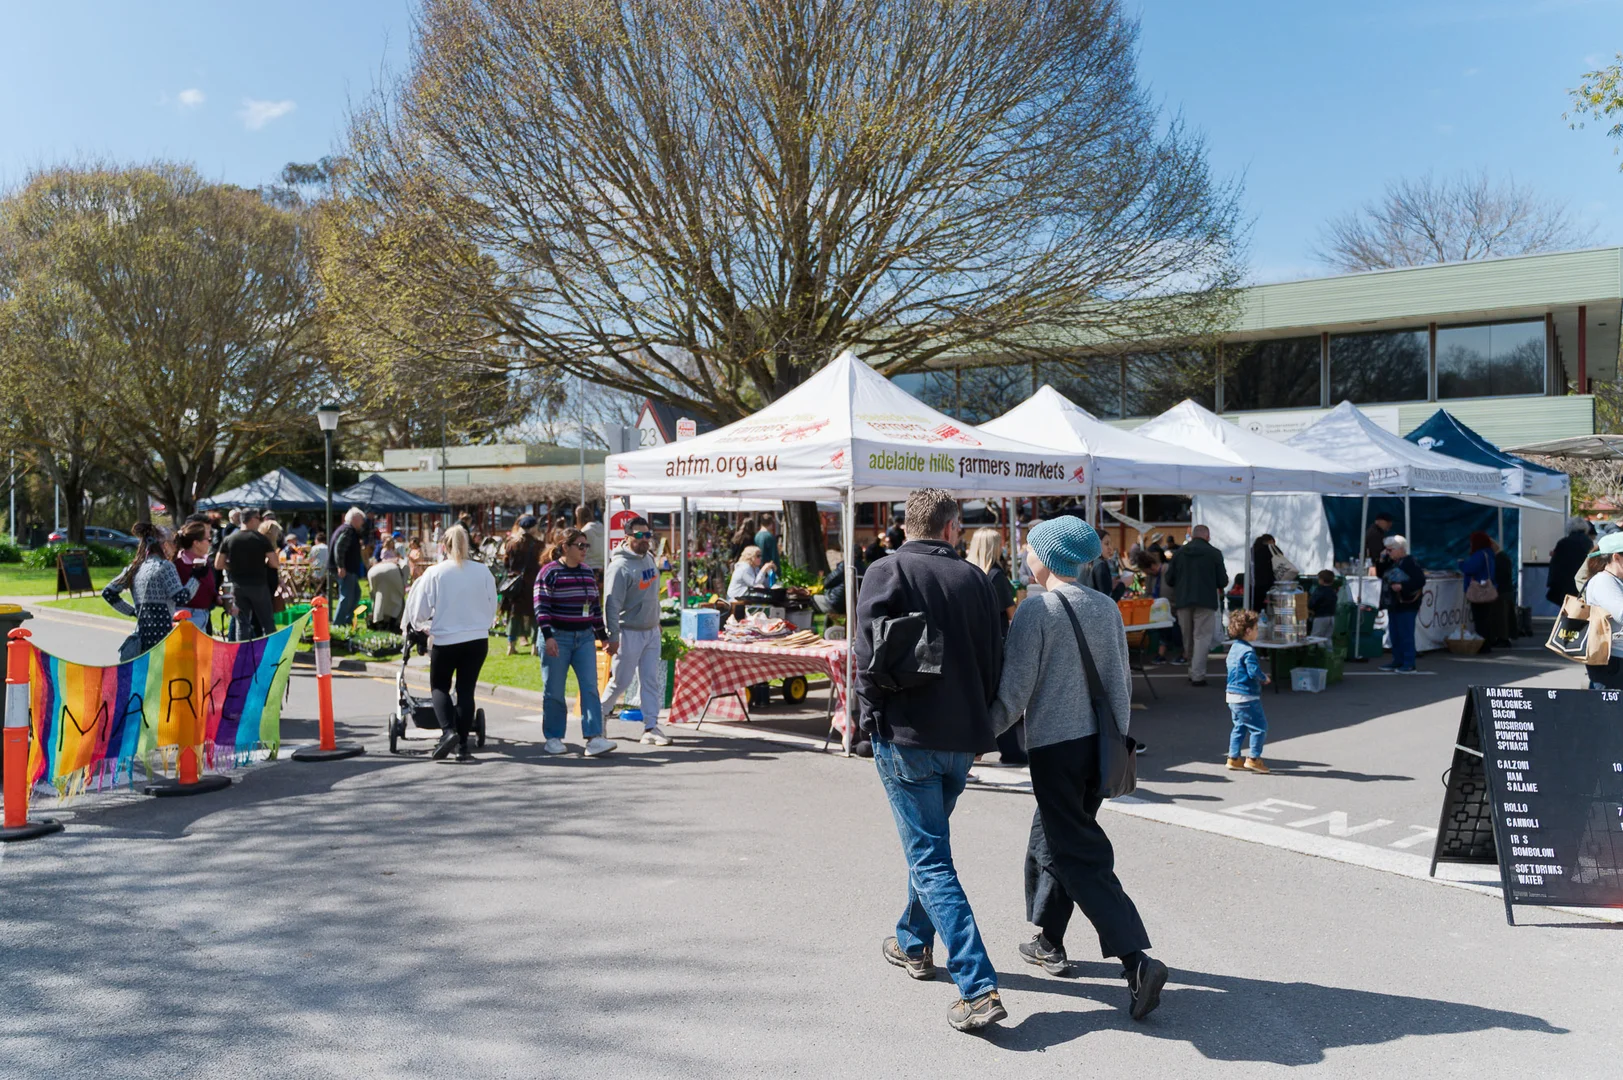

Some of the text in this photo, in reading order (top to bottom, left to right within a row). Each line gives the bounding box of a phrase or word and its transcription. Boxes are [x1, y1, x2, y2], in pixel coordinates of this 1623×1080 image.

[640, 428, 657, 447] 23
[665, 454, 778, 478] ahfm.org.au
[869, 450, 1065, 480] adelaide hills farmers markets
[1486, 688, 1523, 698] ARANCINE
[59, 657, 287, 752] MARKET
[1491, 699, 1533, 710] BOLOGNESE
[1492, 709, 1516, 719] BACON
[1494, 721, 1534, 731] MUSHROOM
[1495, 731, 1529, 741] PUMPKIN
[1497, 741, 1529, 751] SPINACH
[1497, 760, 1530, 770] CALZONI
[1506, 772, 1523, 782] HAM
[1506, 782, 1539, 793] SALAME
[1504, 803, 1528, 813] ROLLO
[1506, 818, 1539, 828] CANNOLI
[1512, 846, 1555, 858] BOMBOLONI
[1518, 874, 1544, 885] WATER
